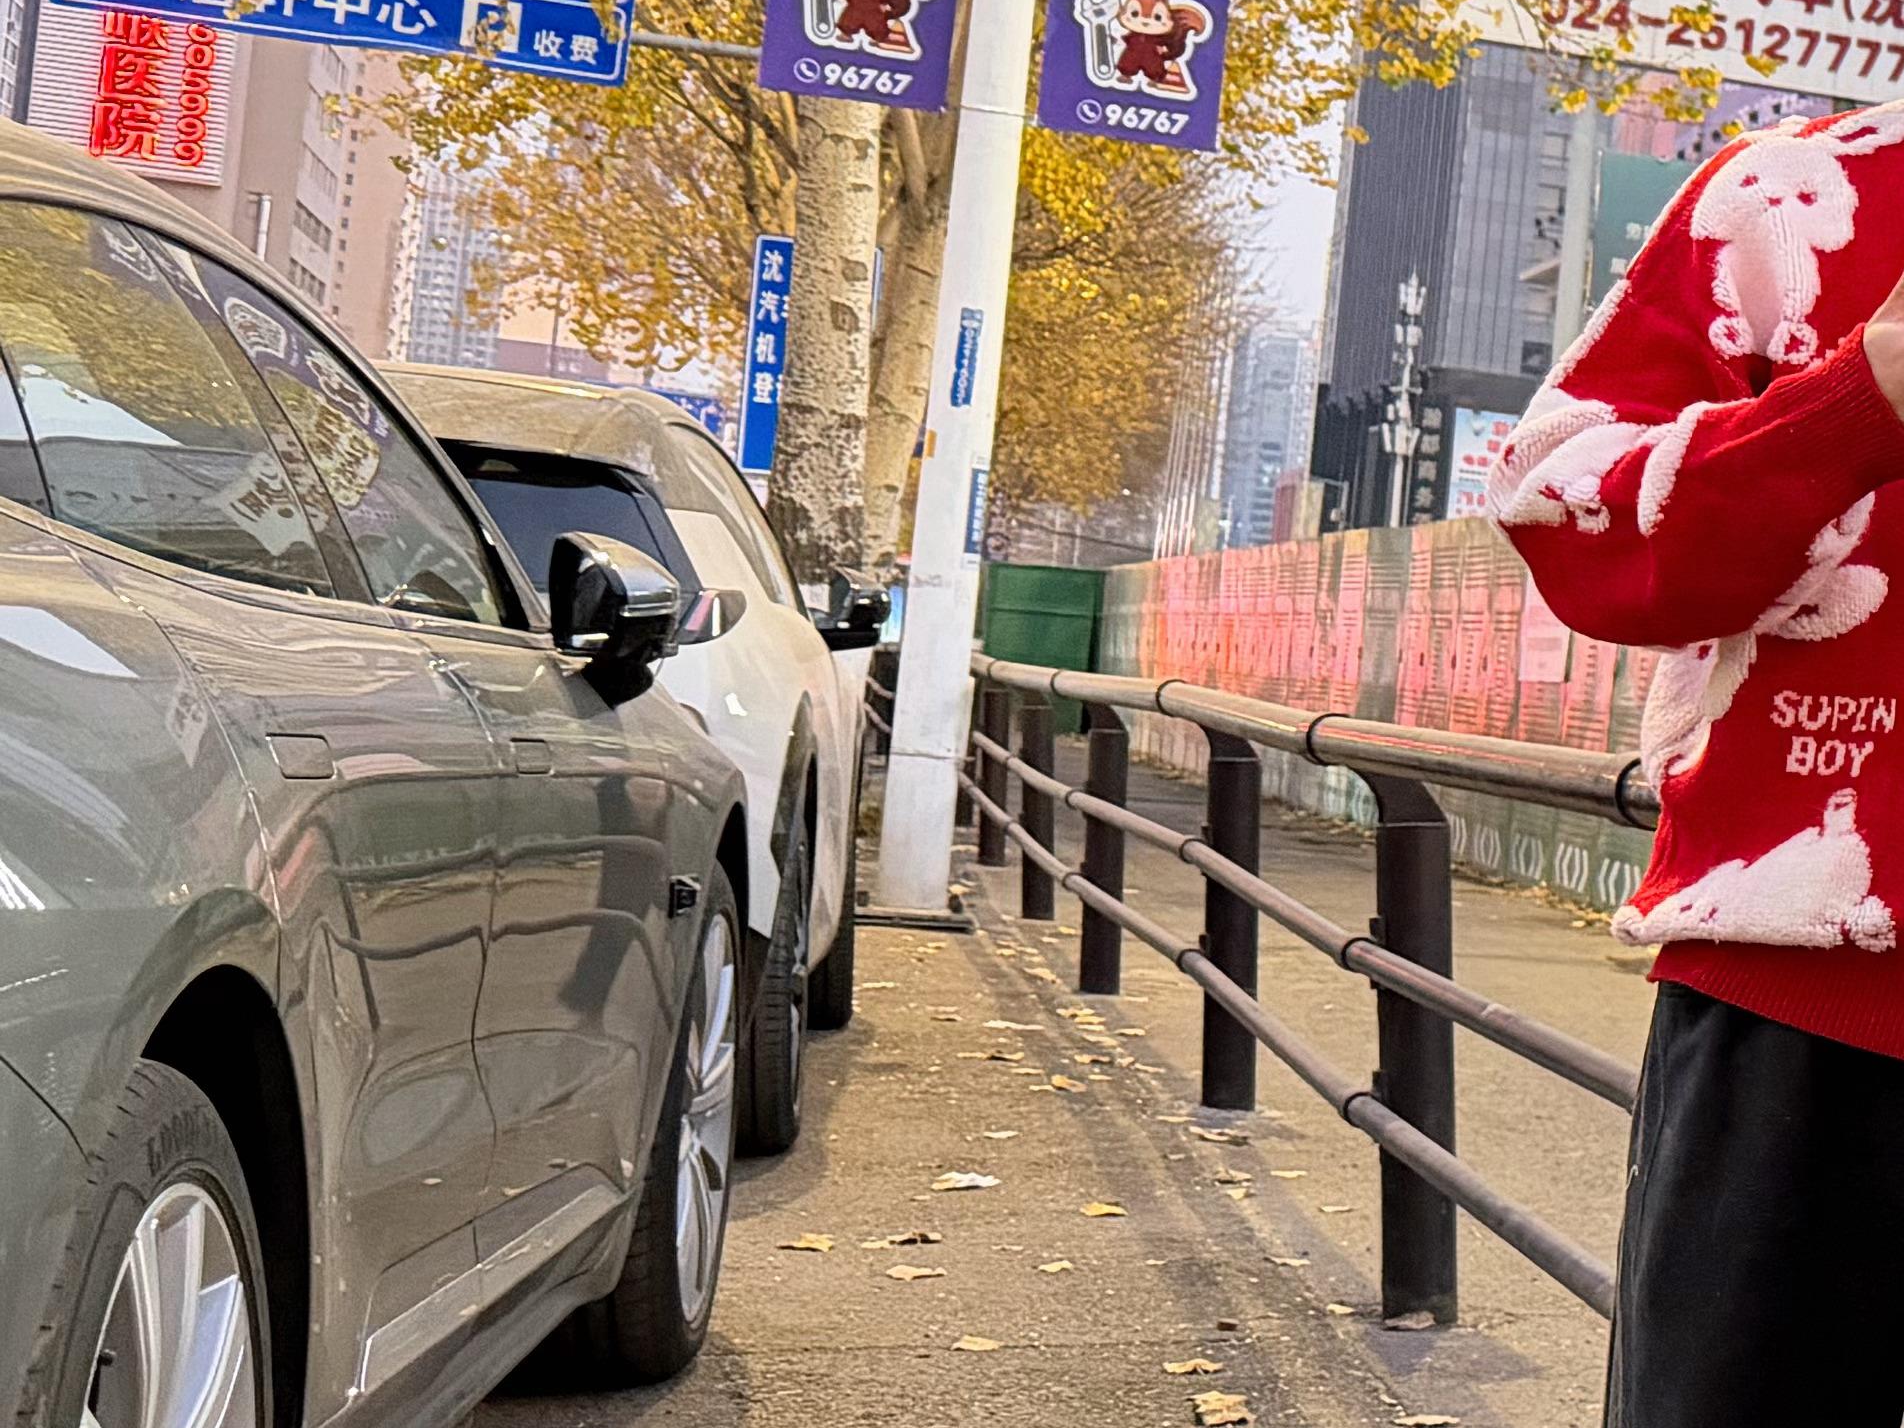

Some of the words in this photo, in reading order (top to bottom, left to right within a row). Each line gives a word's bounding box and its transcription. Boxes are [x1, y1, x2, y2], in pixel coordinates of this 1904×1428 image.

[533, 29, 598, 65] 收费
[823, 63, 913, 96] 96767
[1104, 104, 1189, 134] 96767
[1770, 690, 1897, 733] SUPIN
[1785, 736, 1875, 778] BOY
